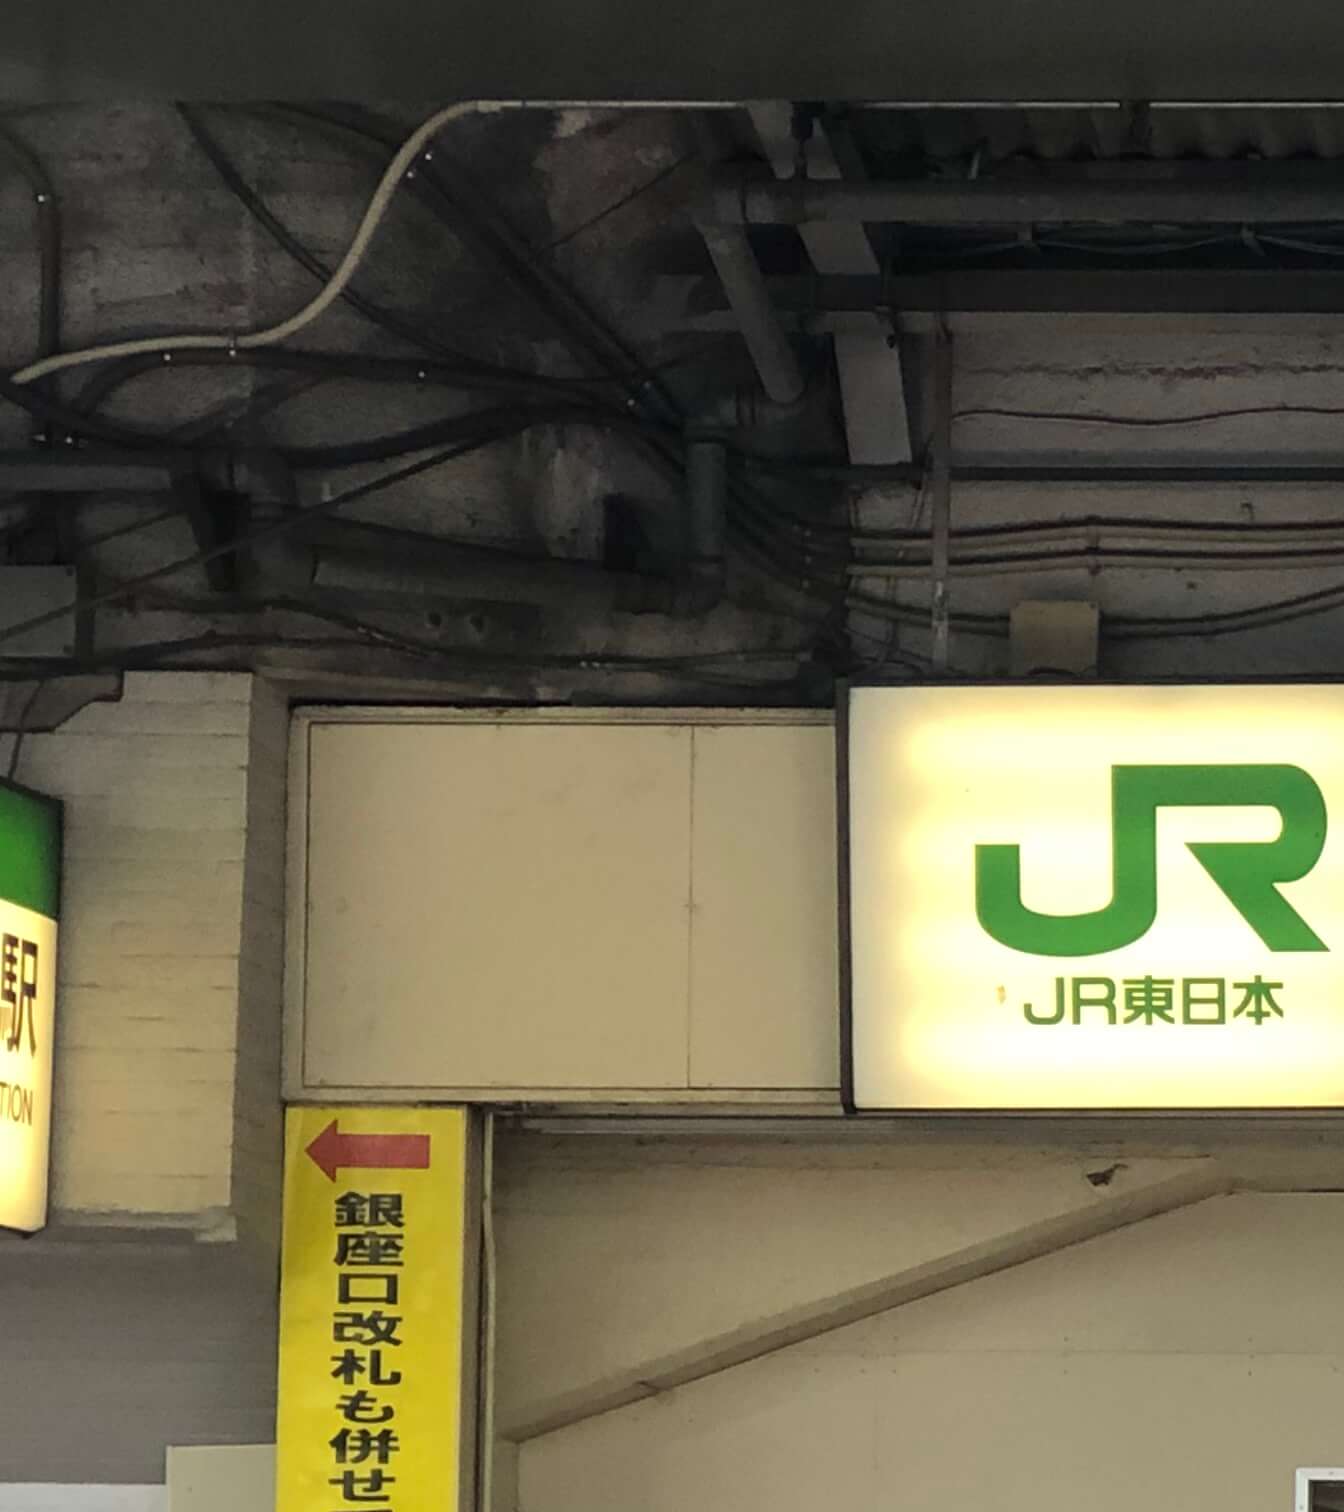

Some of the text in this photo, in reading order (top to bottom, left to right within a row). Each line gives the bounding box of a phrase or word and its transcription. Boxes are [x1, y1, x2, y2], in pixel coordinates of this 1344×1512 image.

[975, 763, 1331, 957] JR
[1024, 975, 1285, 1026] JR東日本
